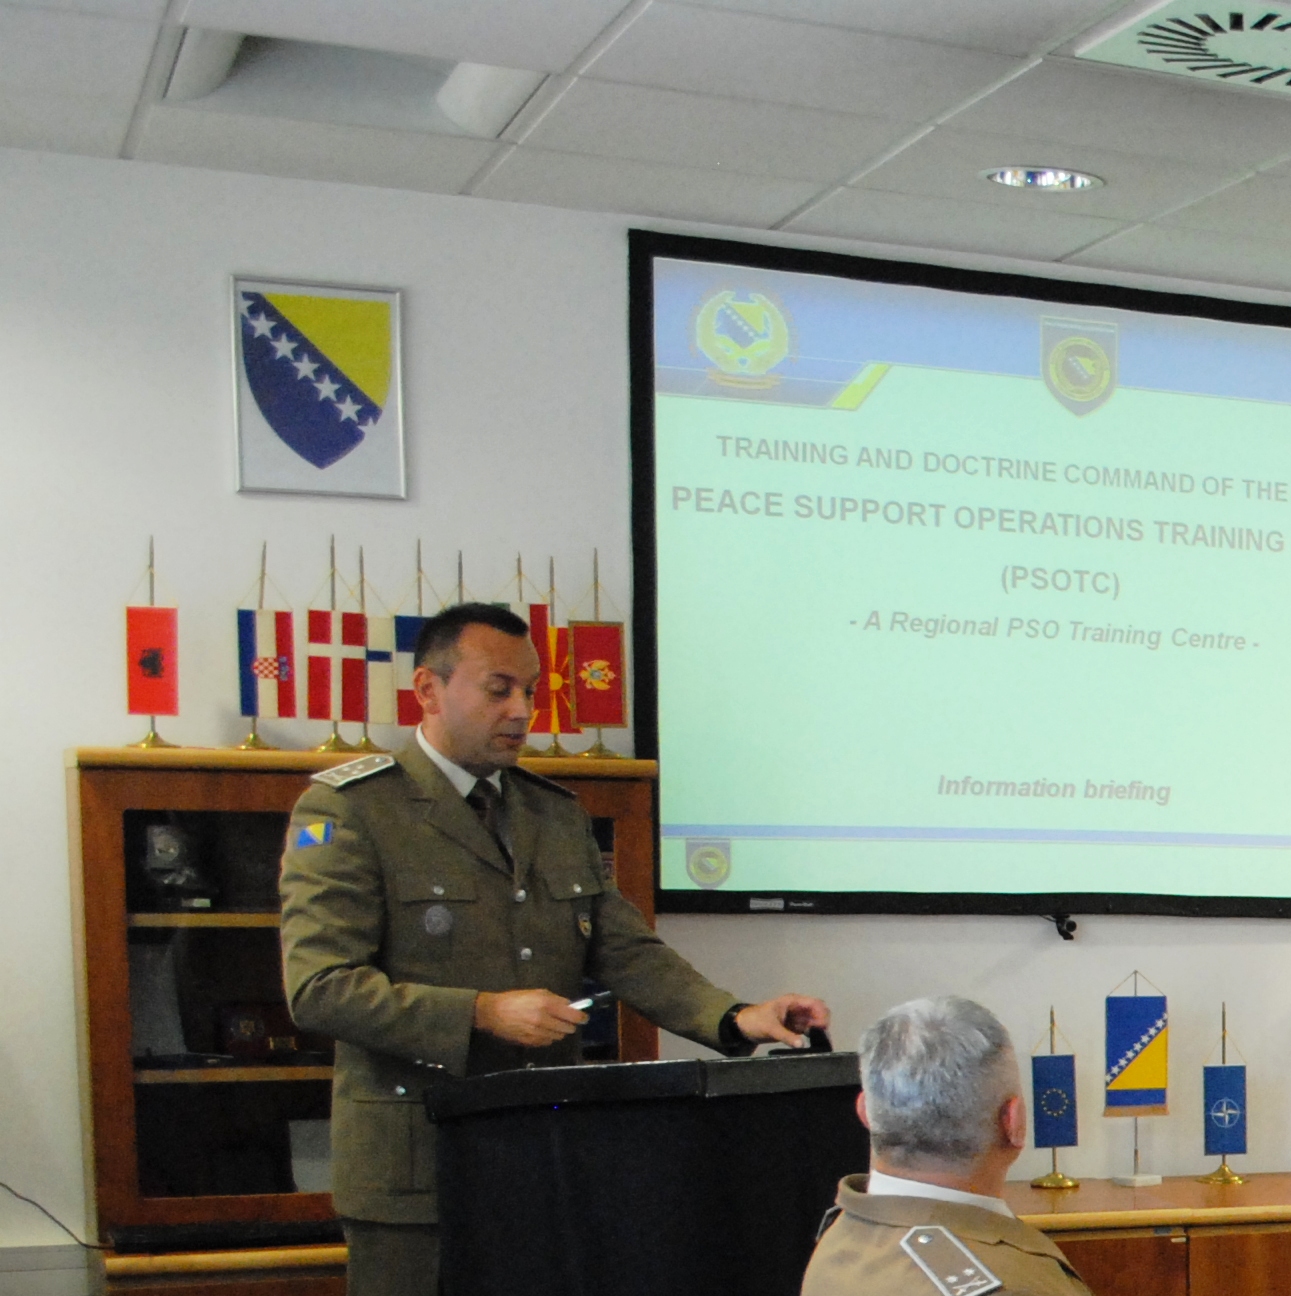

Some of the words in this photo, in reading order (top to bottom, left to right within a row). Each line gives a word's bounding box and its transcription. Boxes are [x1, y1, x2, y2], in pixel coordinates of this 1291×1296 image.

[716, 435, 849, 466] TRAINING
[856, 446, 913, 470] AND
[923, 452, 1057, 482] DOCTRINE
[1063, 463, 1195, 494] COMMAND
[1202, 476, 1235, 497] OF
[1242, 479, 1288, 502] THE
[671, 486, 785, 517] PEACE
[794, 495, 946, 528] SUPPORT
[954, 505, 1144, 542] OPERATIONS
[1153, 519, 1286, 553] TRAINING
[1000, 565, 1121, 601] (PSOTC)
[863, 610, 883, 632] A
[889, 611, 999, 640] Regional
[1007, 617, 1060, 640] PSO
[1069, 620, 1161, 651] Training
[1171, 626, 1247, 651] Centre
[937, 775, 1076, 799] Information
[1083, 779, 1172, 807] briefing
